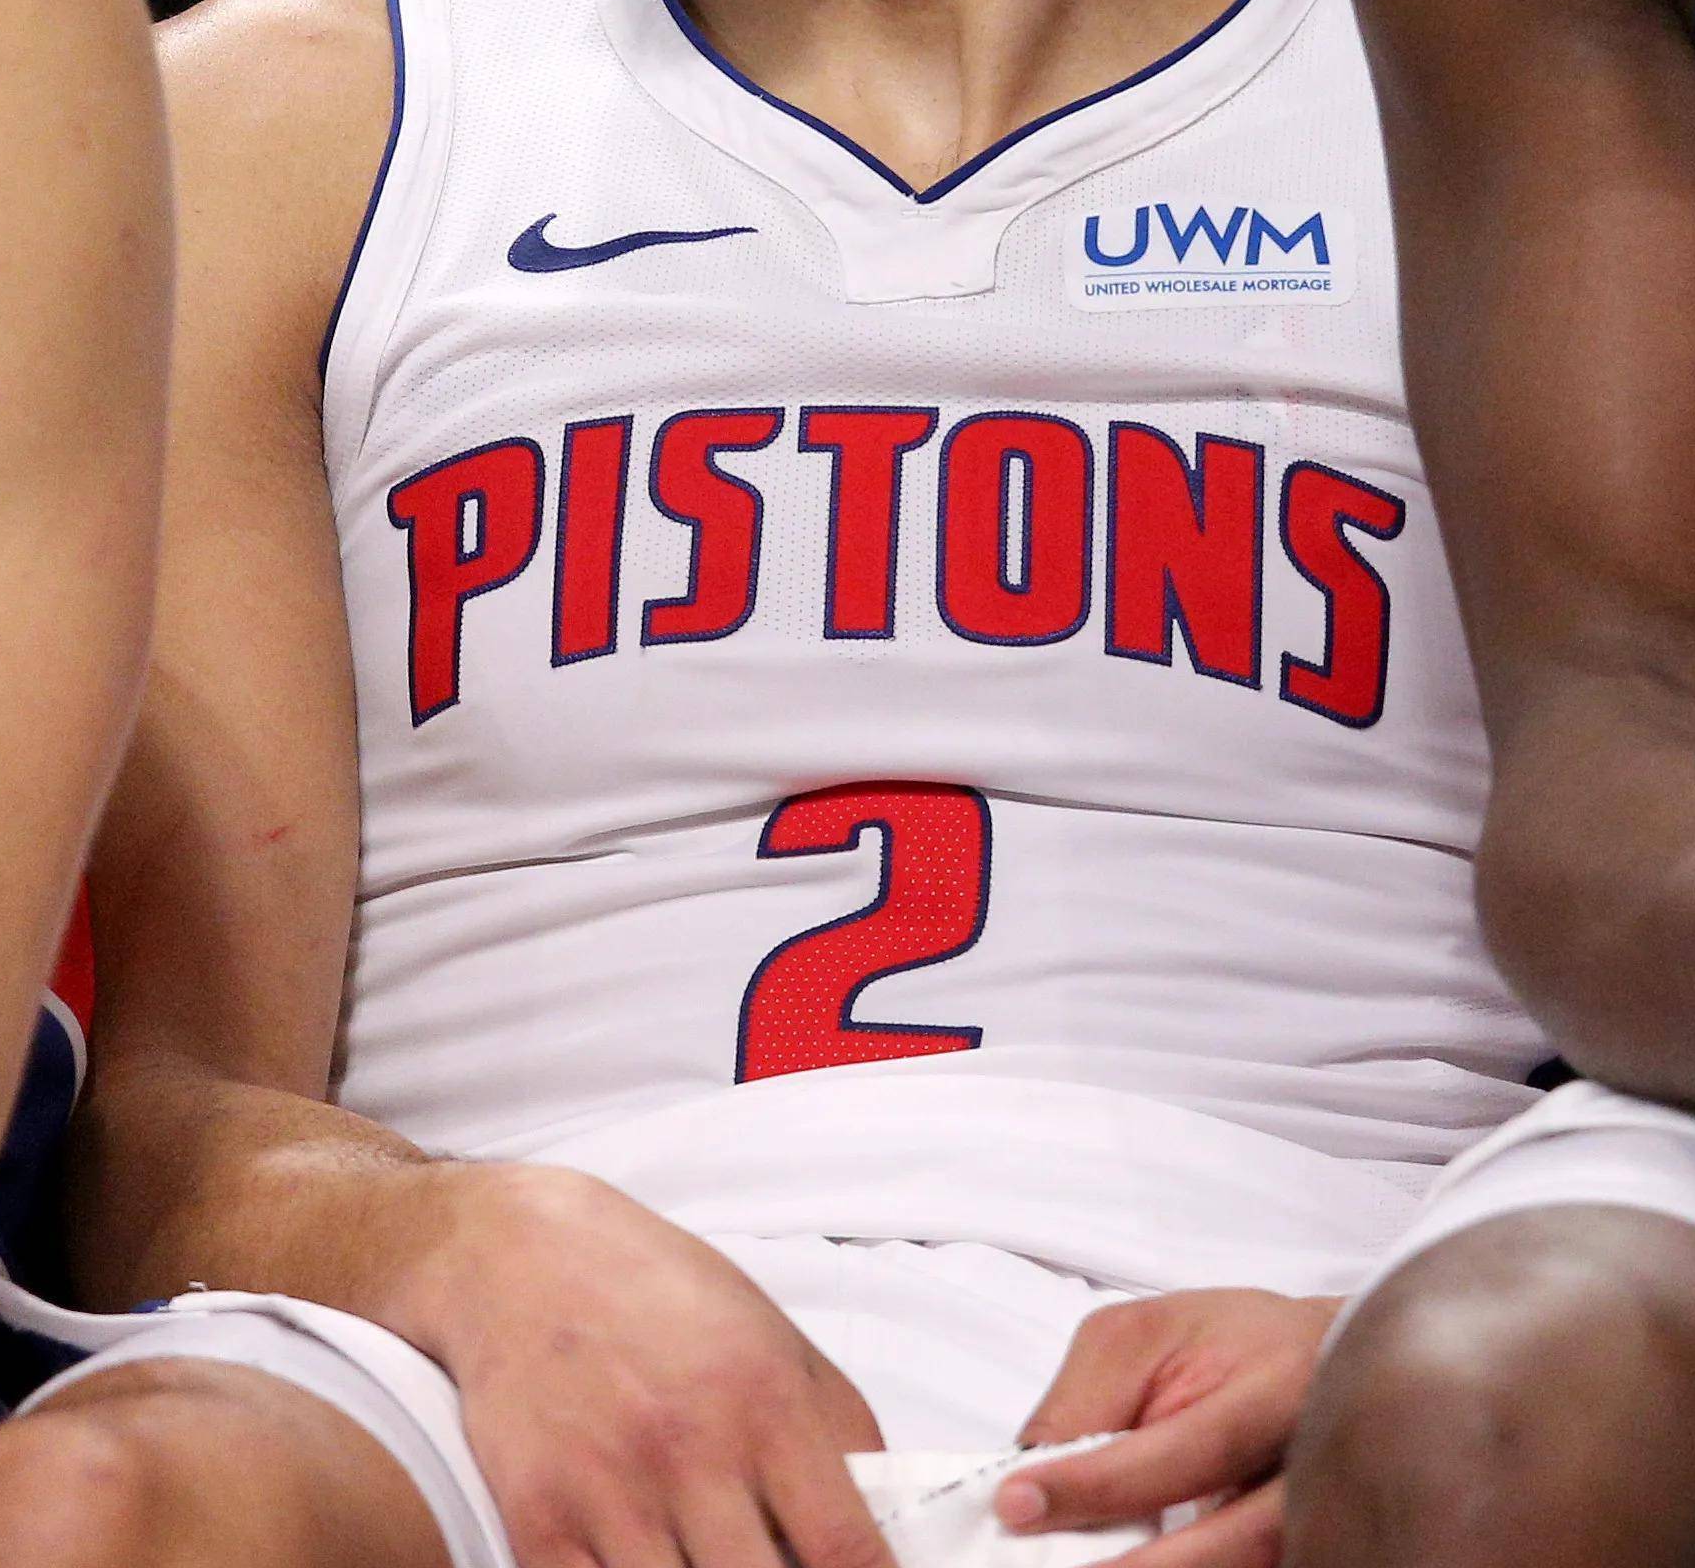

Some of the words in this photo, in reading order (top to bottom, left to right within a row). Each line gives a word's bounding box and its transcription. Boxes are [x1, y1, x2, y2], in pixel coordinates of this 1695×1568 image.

[1084, 203, 1330, 267] UWM
[1085, 281, 1140, 297] UNITED
[1145, 279, 1237, 293] WHOLESALE
[1242, 278, 1331, 292] MORTGAGE
[388, 405, 1406, 730] PISTONS
[735, 779, 992, 1086] 2
